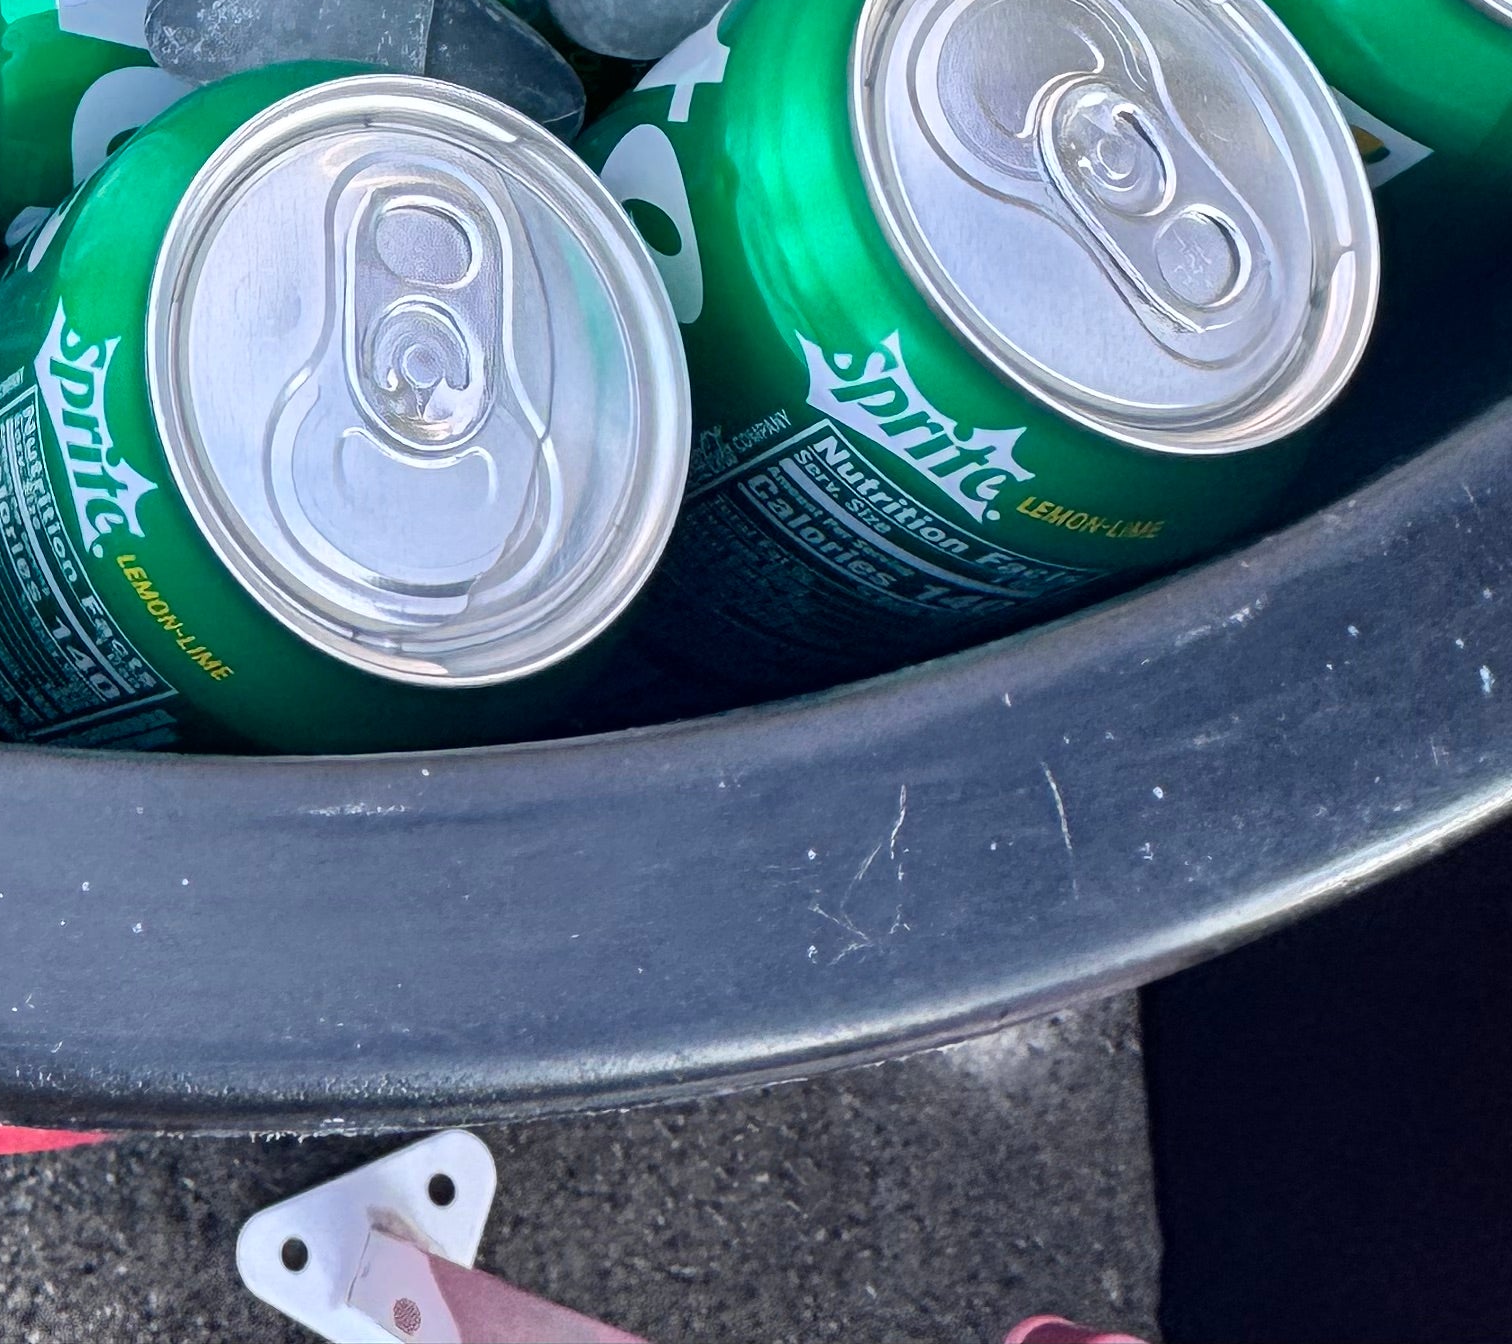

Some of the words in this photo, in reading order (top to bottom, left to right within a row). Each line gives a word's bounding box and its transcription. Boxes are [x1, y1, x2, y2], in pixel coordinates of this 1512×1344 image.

[46, 332, 131, 538] Sprite
[825, 340, 1012, 507] Sprite
[21, 403, 78, 583] Nutrition
[747, 474, 897, 587] Calories
[793, 445, 841, 499] Serv.
[844, 500, 892, 534] Size
[812, 435, 970, 553] Nutrition
[1015, 495, 1166, 539] LEMON-LIME
[51, 615, 120, 703] 140
[116, 553, 235, 683] LEMON-LIME
